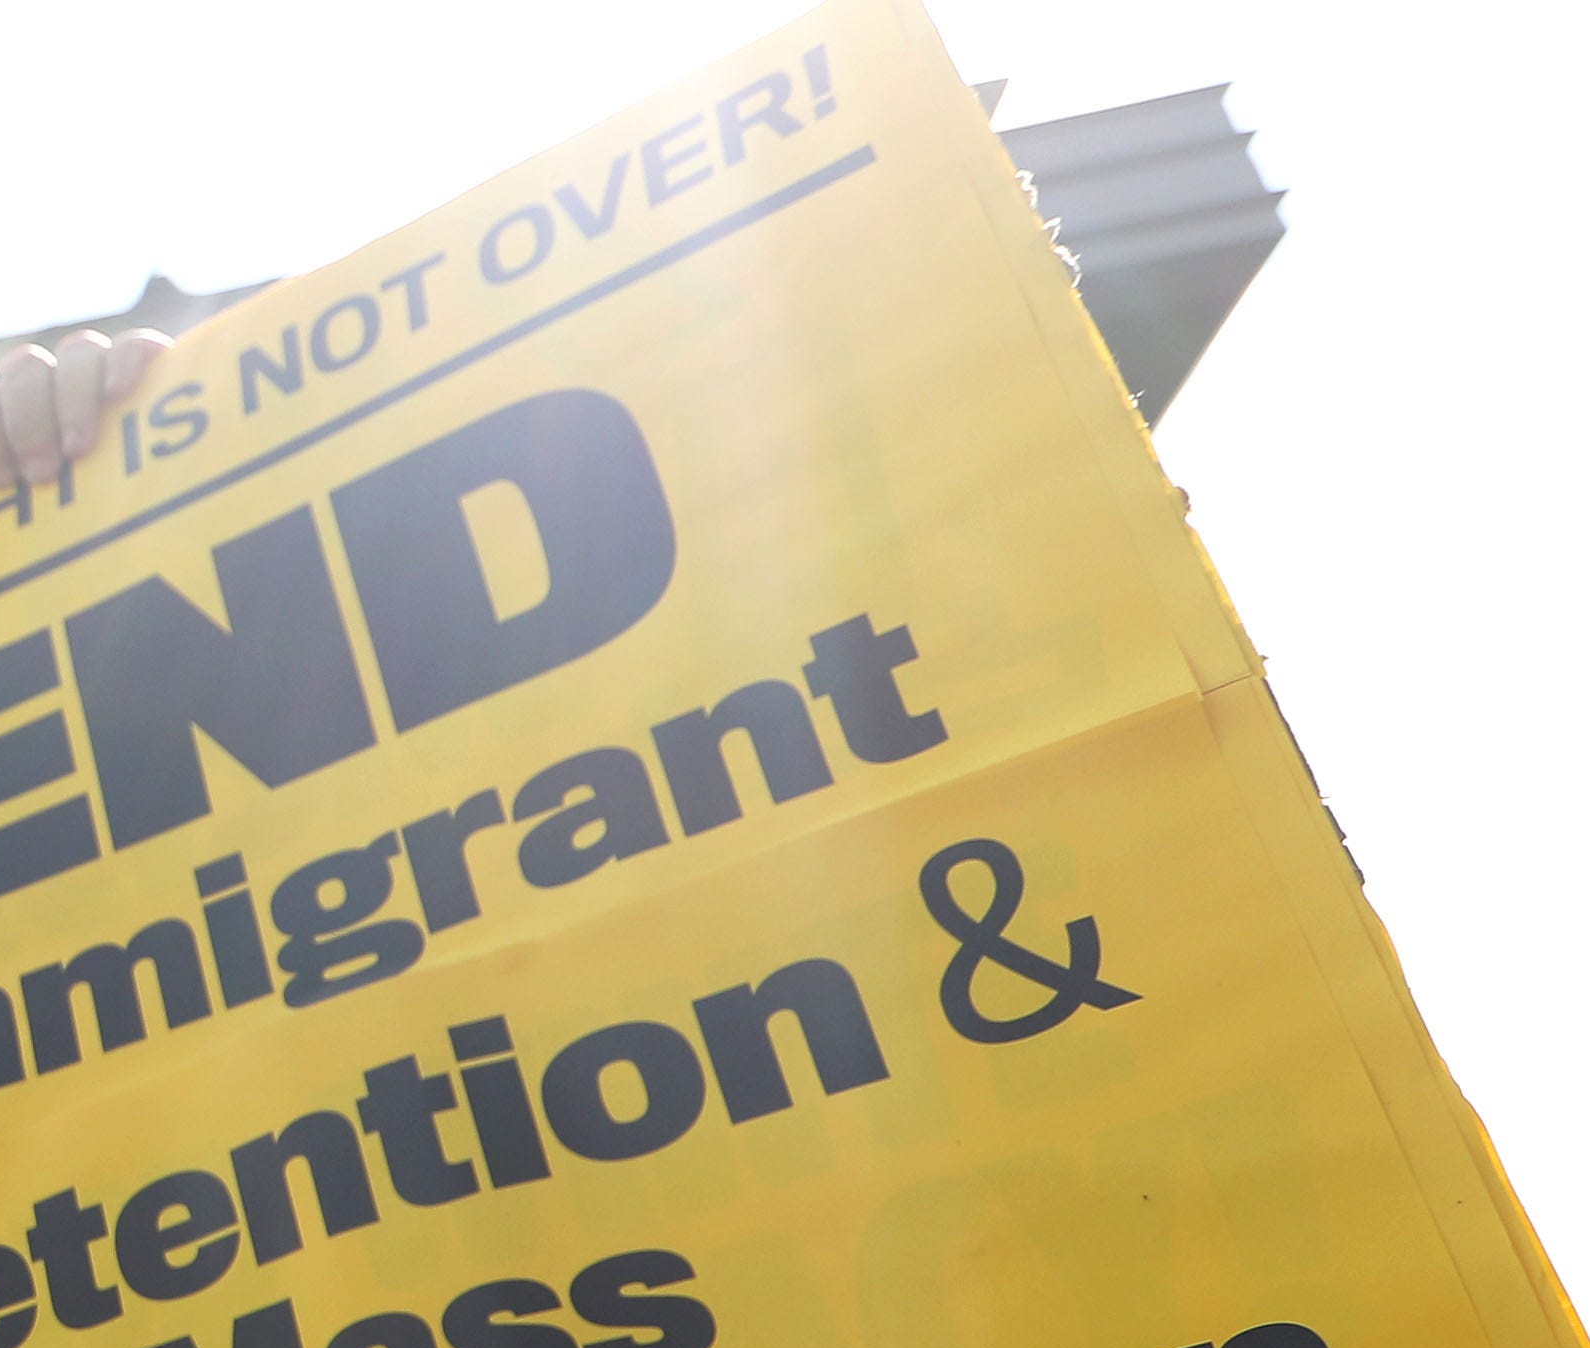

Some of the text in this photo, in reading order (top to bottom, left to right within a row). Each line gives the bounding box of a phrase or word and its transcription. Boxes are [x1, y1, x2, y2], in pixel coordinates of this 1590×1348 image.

[120, 381, 212, 476] IS
[236, 250, 447, 417] NOT
[477, 42, 840, 287] OVER!
[918, 838, 1145, 1046] &
